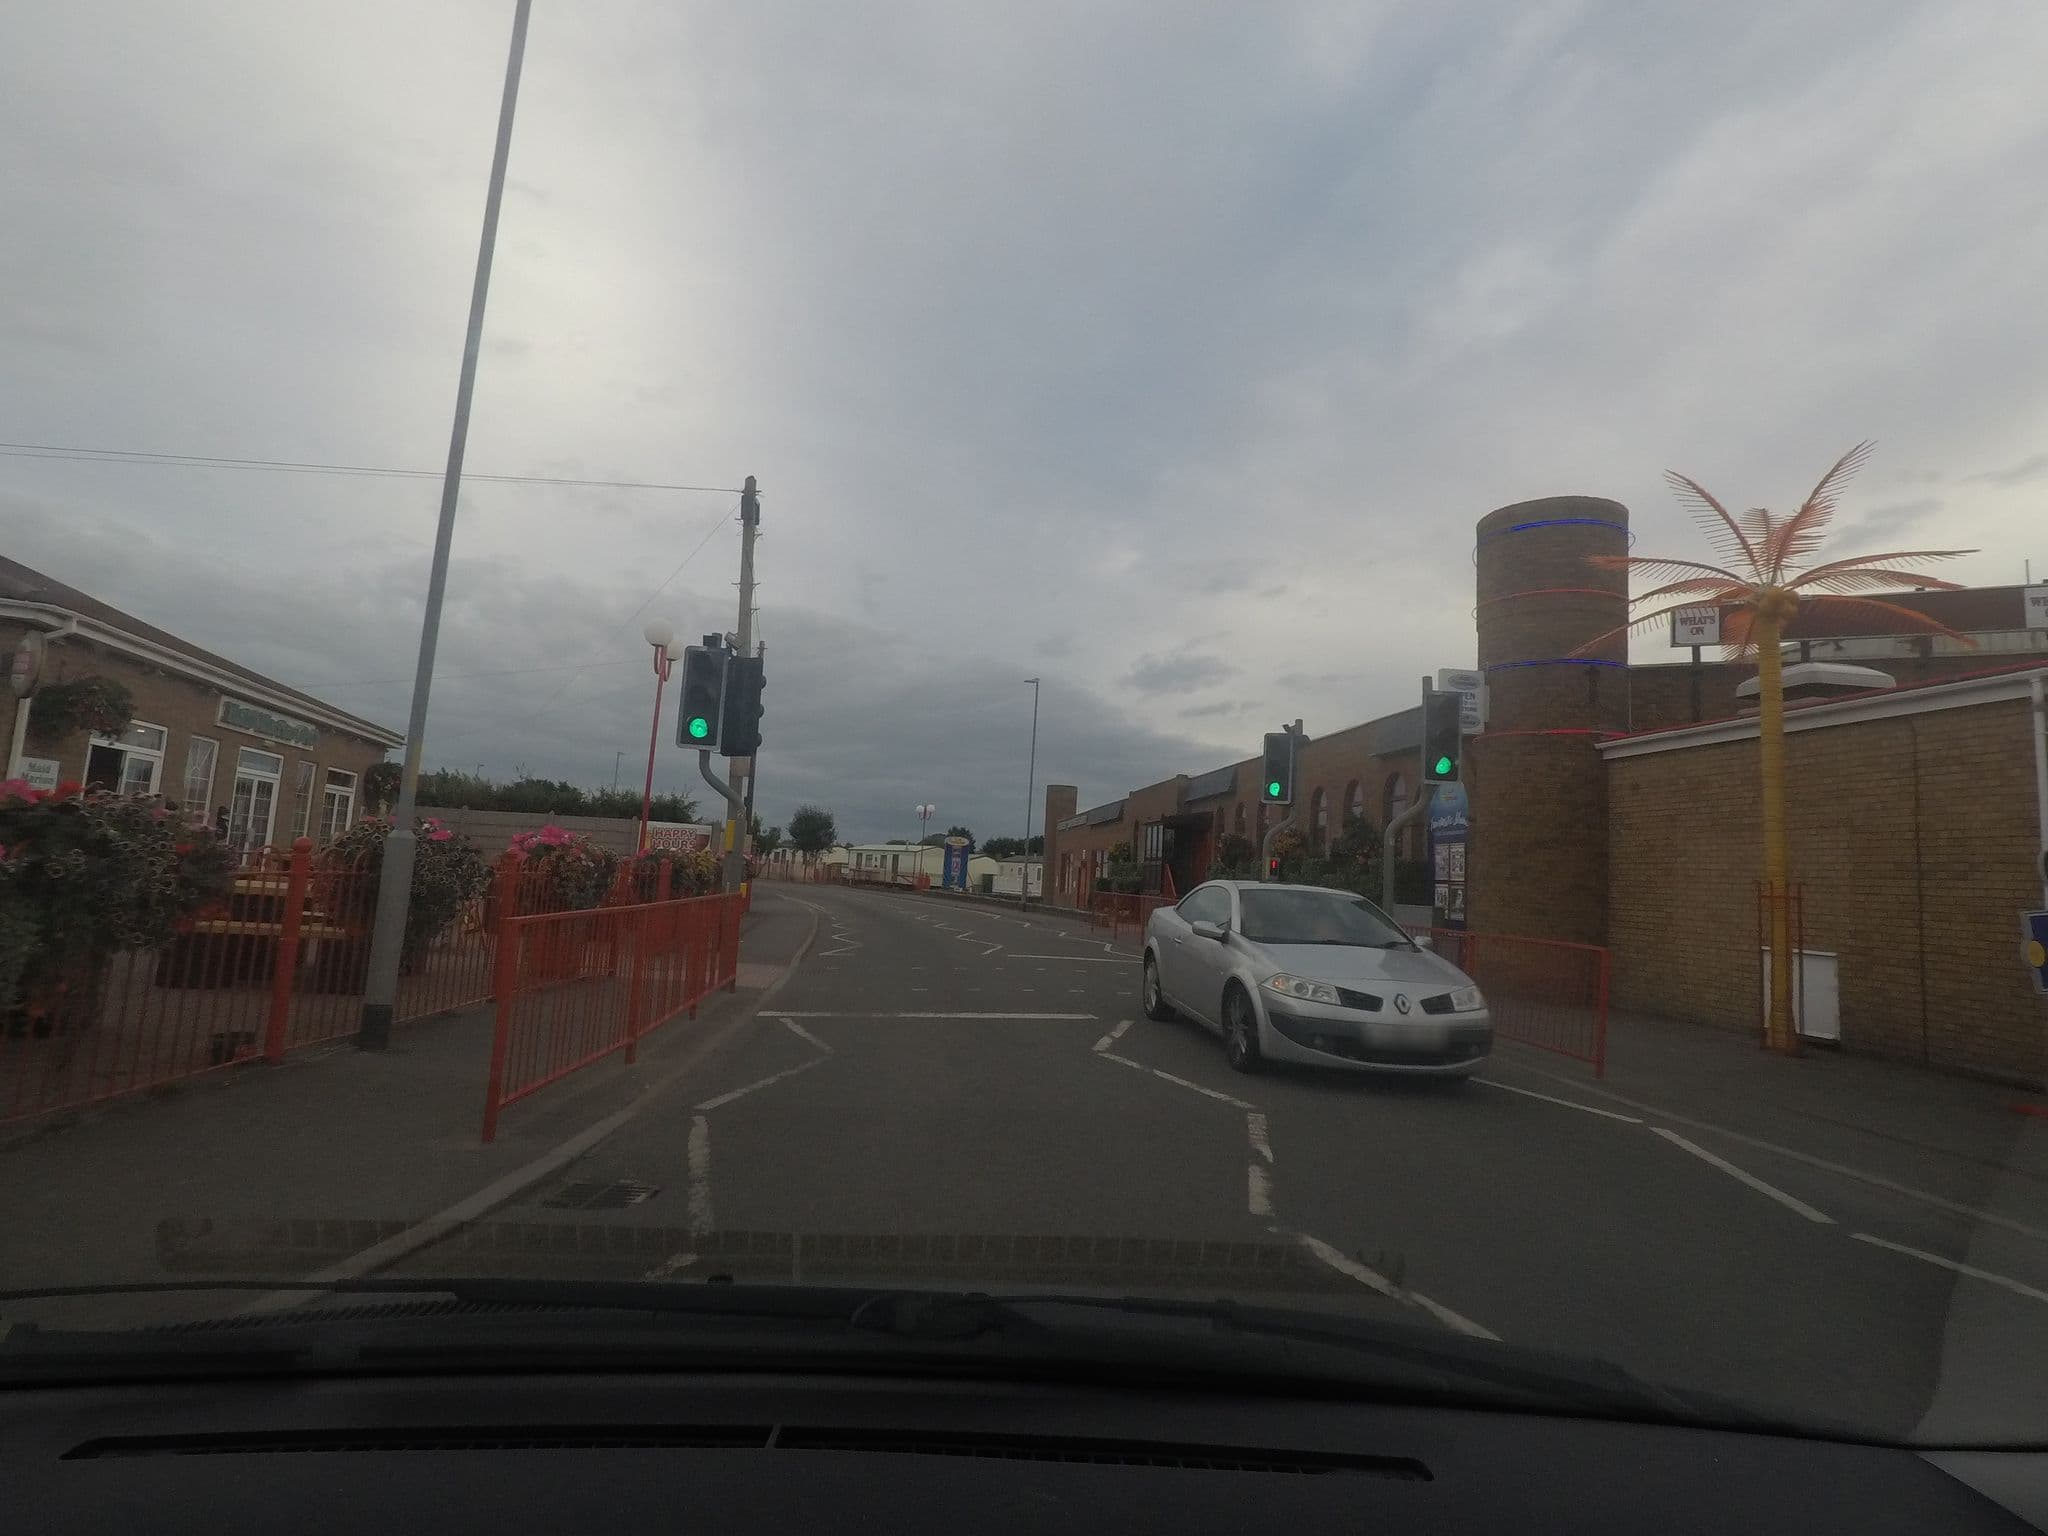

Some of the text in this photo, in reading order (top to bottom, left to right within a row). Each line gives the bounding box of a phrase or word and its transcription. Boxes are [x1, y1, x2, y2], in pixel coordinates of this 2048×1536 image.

[1691, 627, 1704, 635] ON
[654, 828, 696, 839] HAPPY
[652, 839, 696, 850] HOURS
